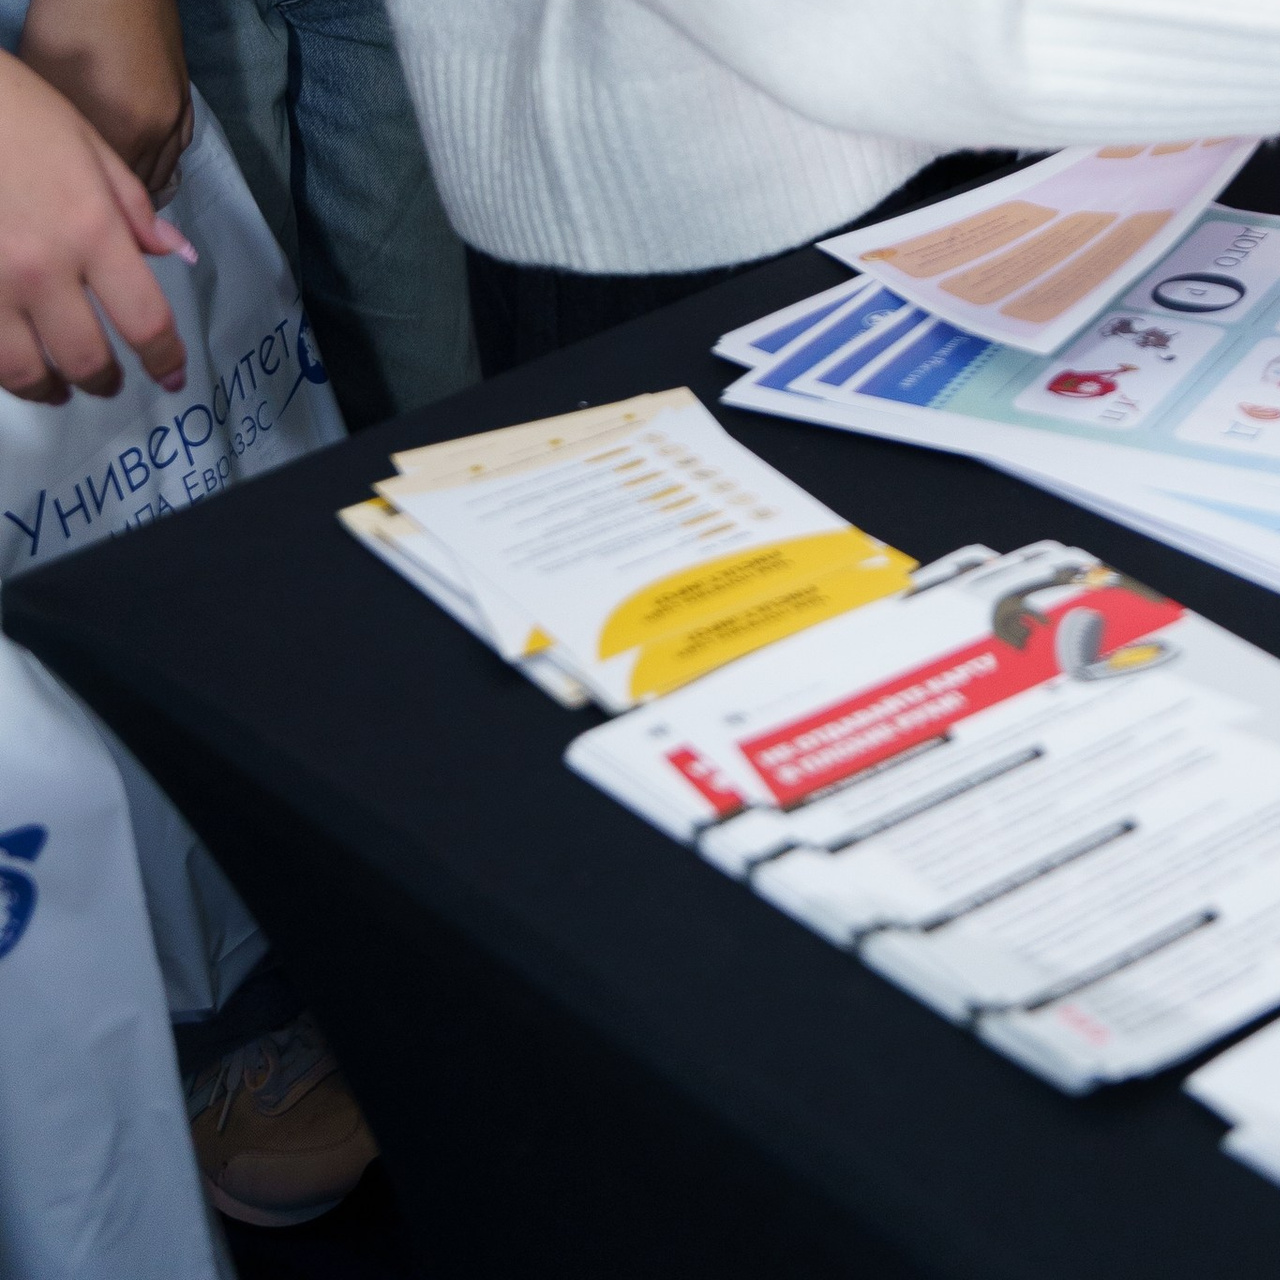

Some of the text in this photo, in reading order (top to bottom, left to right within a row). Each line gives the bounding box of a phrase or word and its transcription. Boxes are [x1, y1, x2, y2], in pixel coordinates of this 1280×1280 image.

[1214, 226, 1268, 268] ДОГО
[4, 318, 290, 557] Университет
[110, 493, 176, 539] ПА
